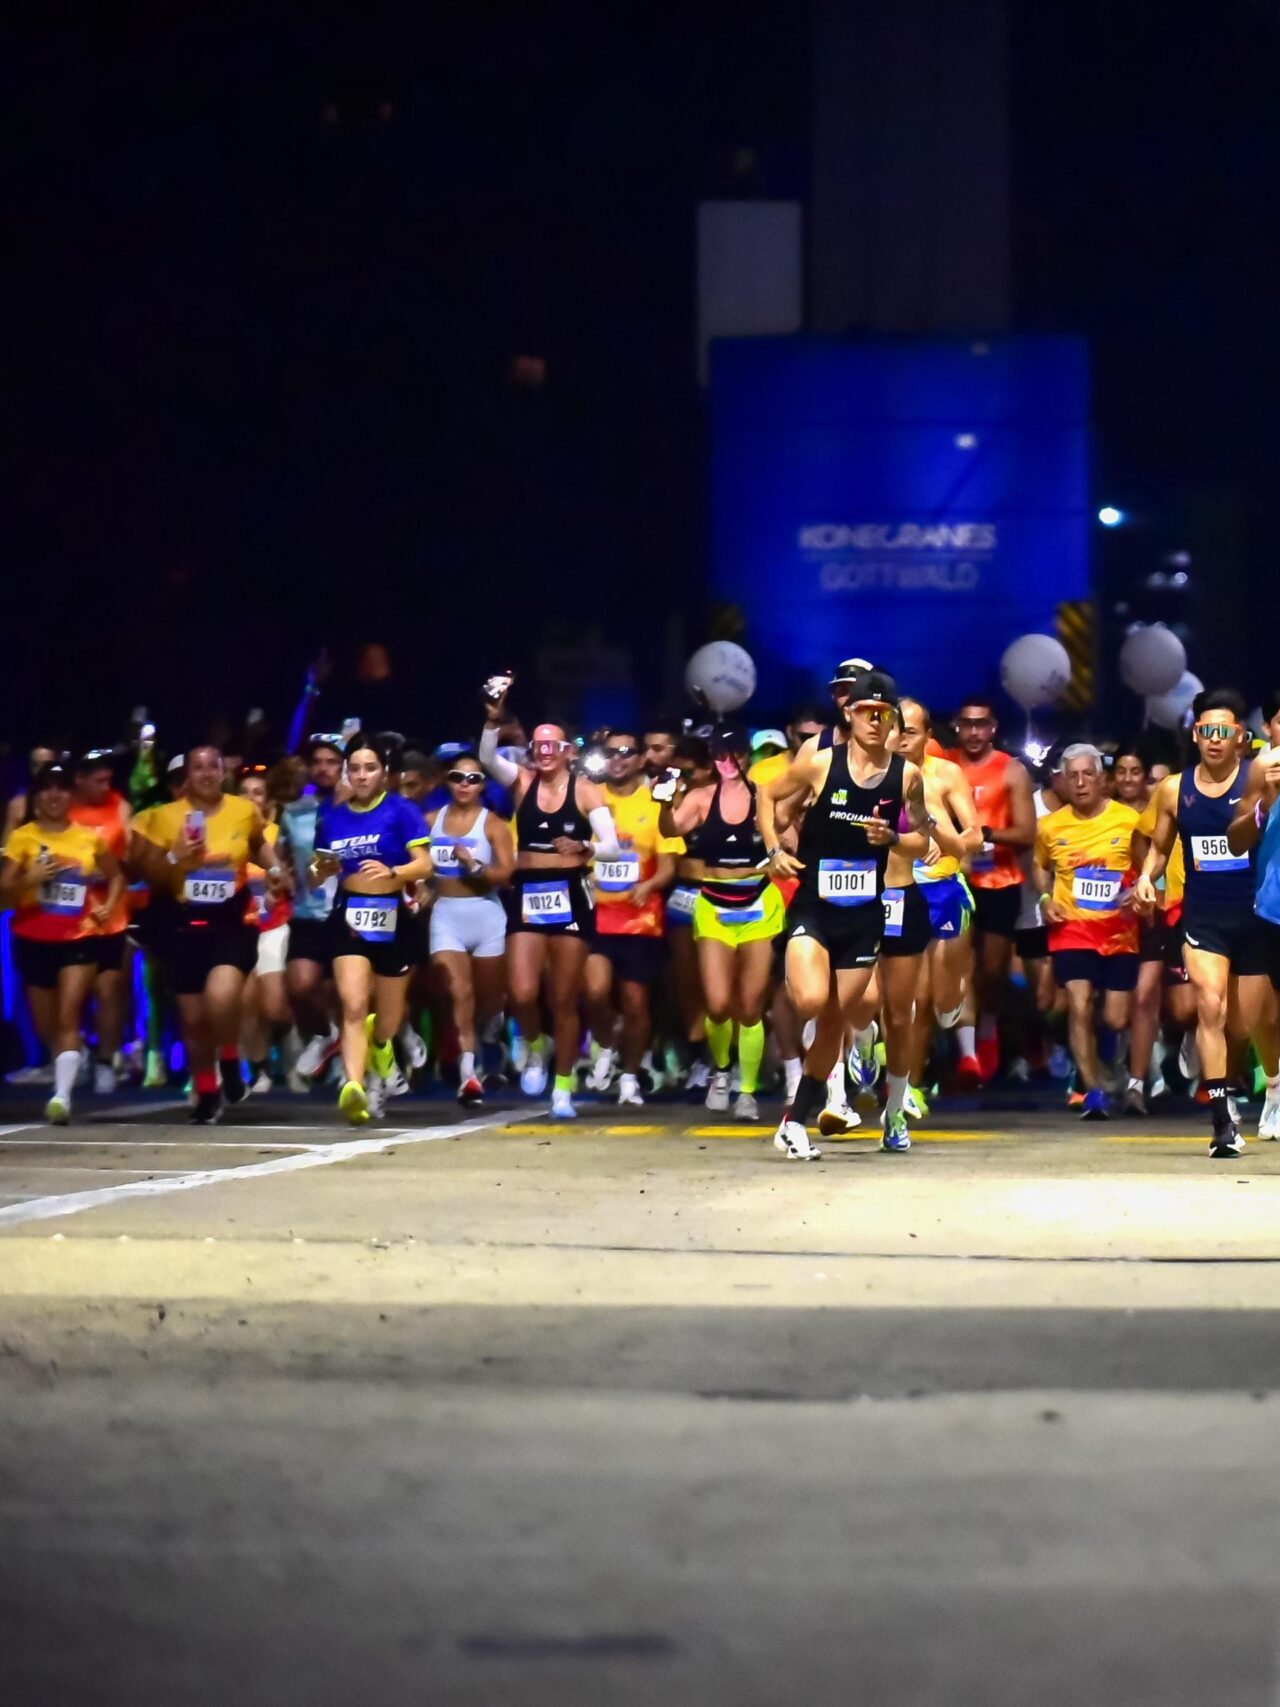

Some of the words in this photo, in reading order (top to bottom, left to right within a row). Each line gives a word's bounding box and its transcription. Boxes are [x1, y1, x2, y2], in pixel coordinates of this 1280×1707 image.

[343, 834, 380, 849] TEAM
[1202, 839, 1228, 855] 956
[339, 844, 383, 860] RISTAL
[601, 863, 630, 878] 7667
[828, 873, 865, 891] 10101
[1081, 881, 1112, 898] 10113
[192, 882, 227, 899] 8475
[528, 894, 562, 910] 10124
[355, 910, 388, 928] 9792
